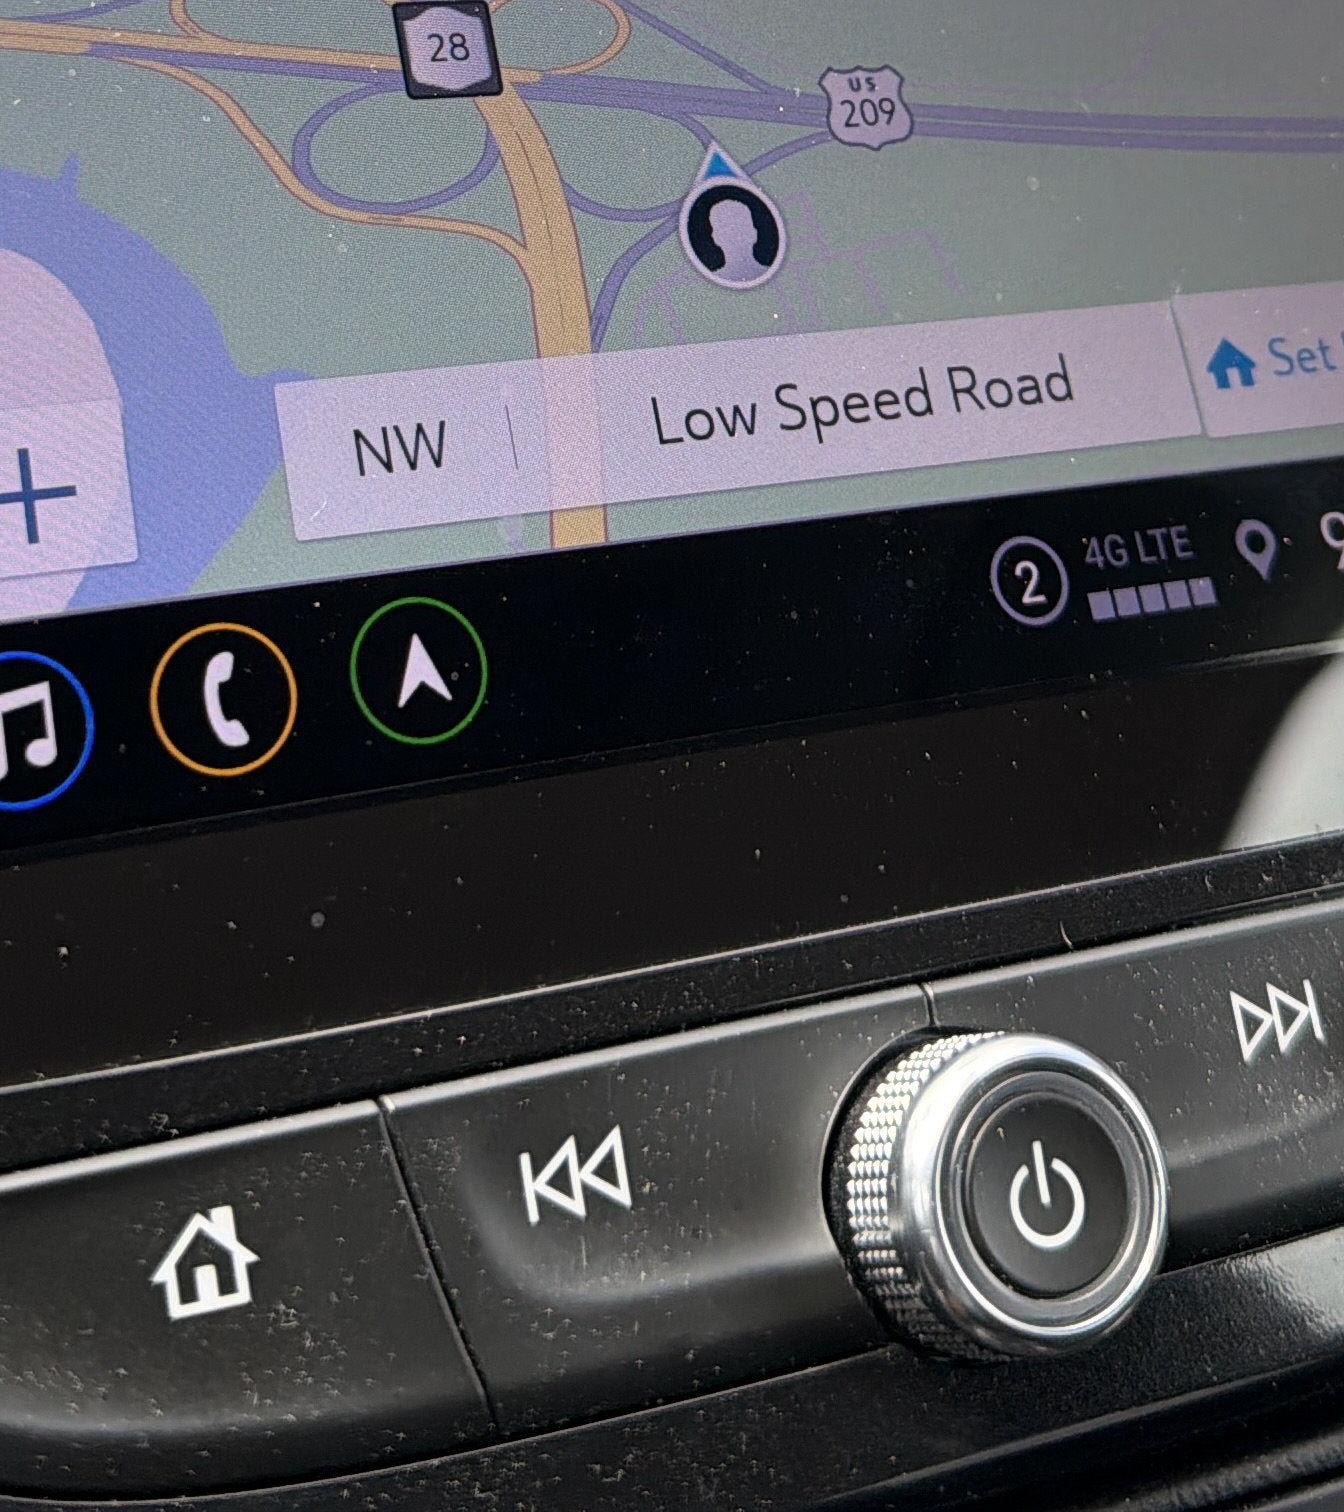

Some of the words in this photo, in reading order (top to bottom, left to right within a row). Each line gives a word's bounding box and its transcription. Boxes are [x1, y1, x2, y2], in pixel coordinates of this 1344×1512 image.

[426, 33, 470, 63] 28
[847, 76, 877, 93] US
[840, 98, 896, 129] 209
[1267, 337, 1337, 376] Set
[650, 395, 757, 445] Low
[774, 366, 934, 443] Speed
[946, 353, 1075, 413] Road
[353, 420, 448, 476] NW
[1083, 539, 1129, 570] 4G
[1134, 525, 1195, 562] LTE
[1012, 559, 1047, 606] 2
